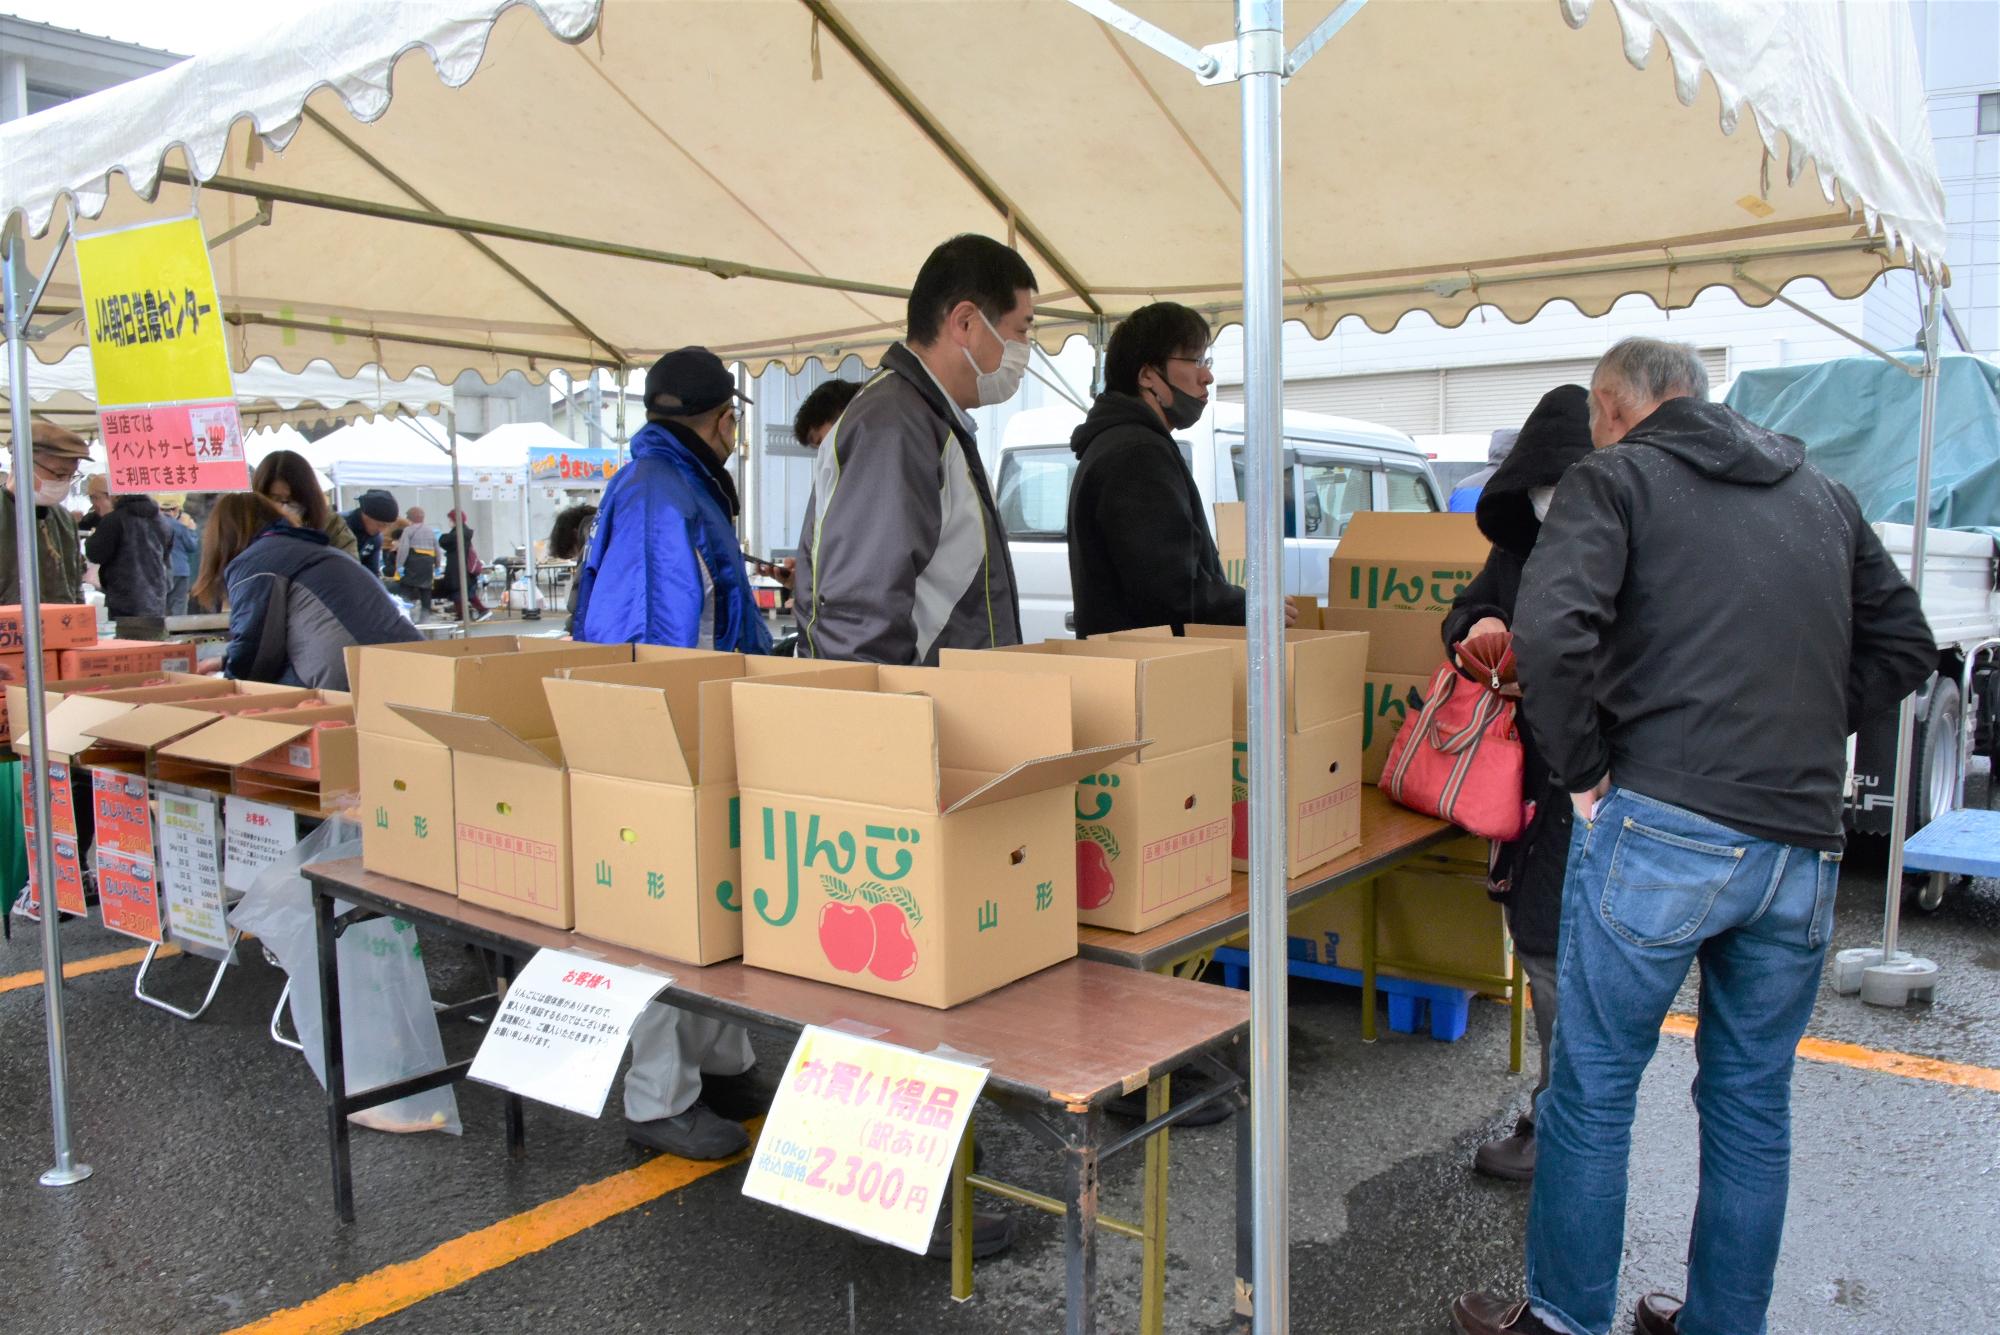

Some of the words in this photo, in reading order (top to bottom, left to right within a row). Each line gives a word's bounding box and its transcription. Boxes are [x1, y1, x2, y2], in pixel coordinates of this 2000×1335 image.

[95, 286, 211, 347] JA朝日営農センター
[106, 414, 153, 434] 当店では
[111, 437, 223, 460] イベントサービス券
[116, 464, 200, 486] ご利用できます
[753, 807, 921, 927] りんご
[561, 968, 611, 989] お客様へ
[794, 1058, 960, 1131] お買い得品
[758, 1152, 808, 1183] 税込価格
